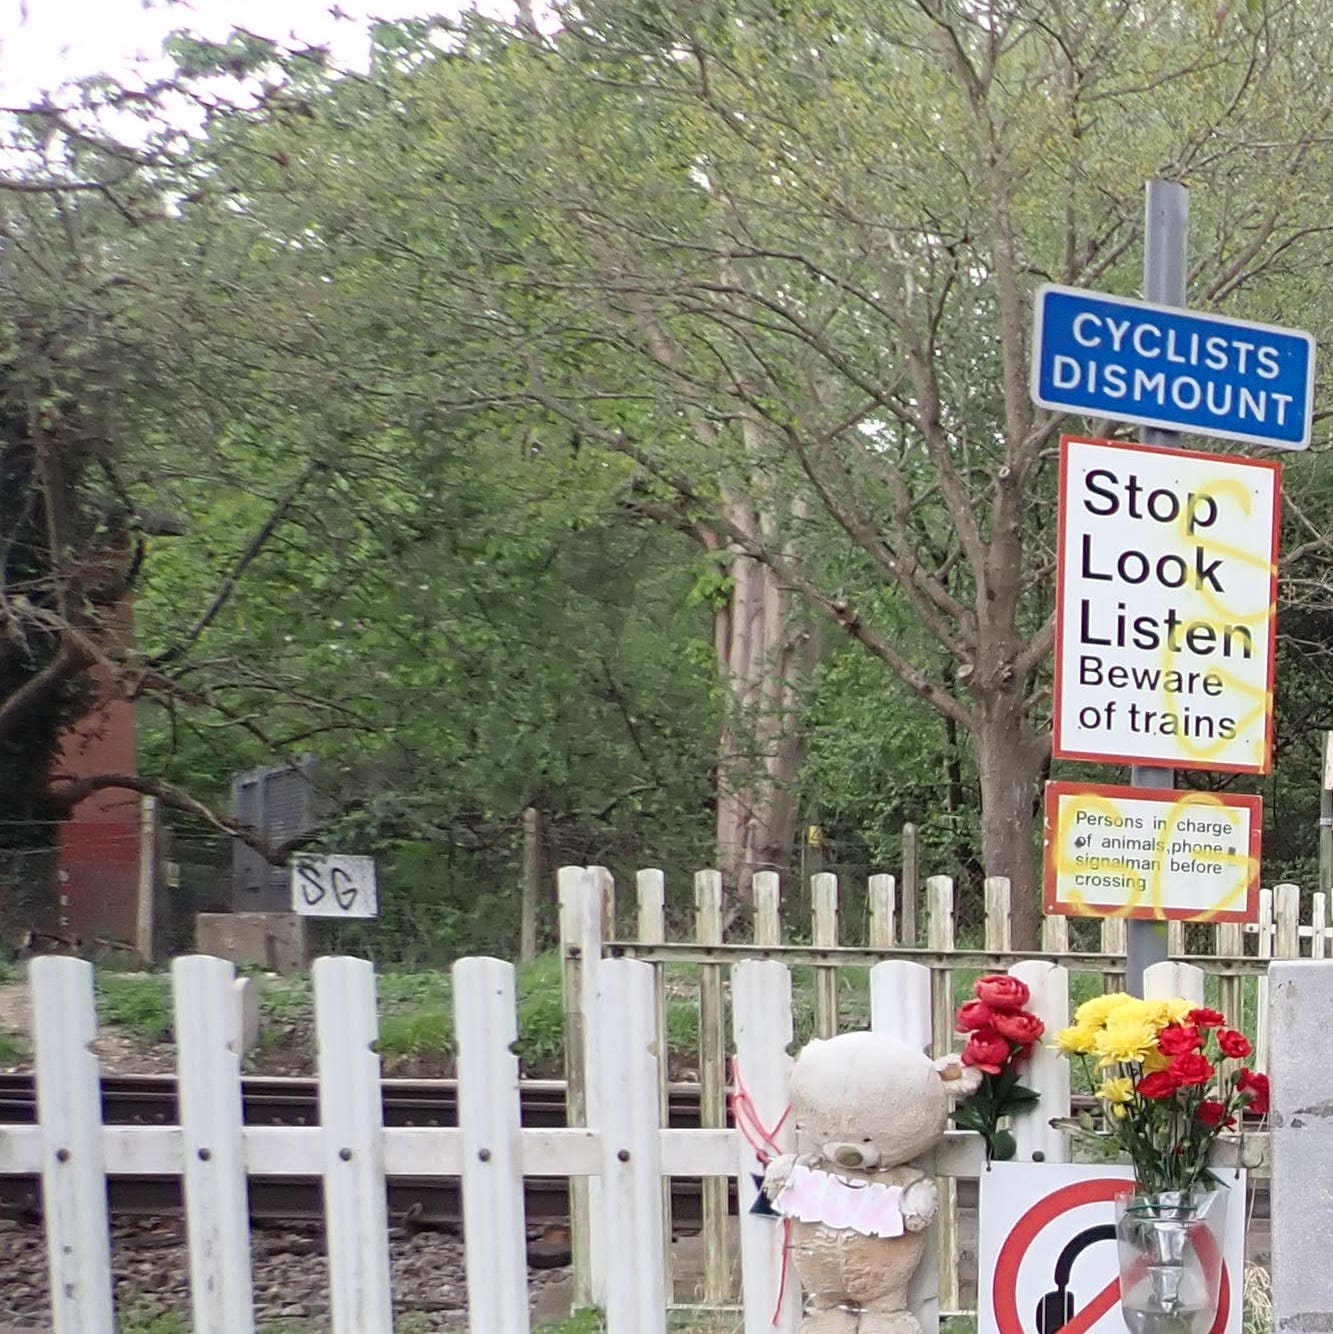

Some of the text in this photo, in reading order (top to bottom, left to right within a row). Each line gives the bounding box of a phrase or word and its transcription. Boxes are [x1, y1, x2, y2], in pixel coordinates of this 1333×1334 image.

[1072, 312, 1280, 379] CYCLISTS
[1052, 354, 1294, 426] DISMOUNT
[1082, 469, 1218, 536] Stop
[1081, 533, 1225, 593] Look
[1080, 599, 1252, 659] Listen
[1080, 655, 1224, 697] Beware
[1079, 701, 1237, 740] of trains
[1074, 835, 1092, 848] of
[1075, 811, 1232, 837] Persons in charge
[1075, 853, 1223, 875] signalman before
[1075, 873, 1147, 892] crossing
